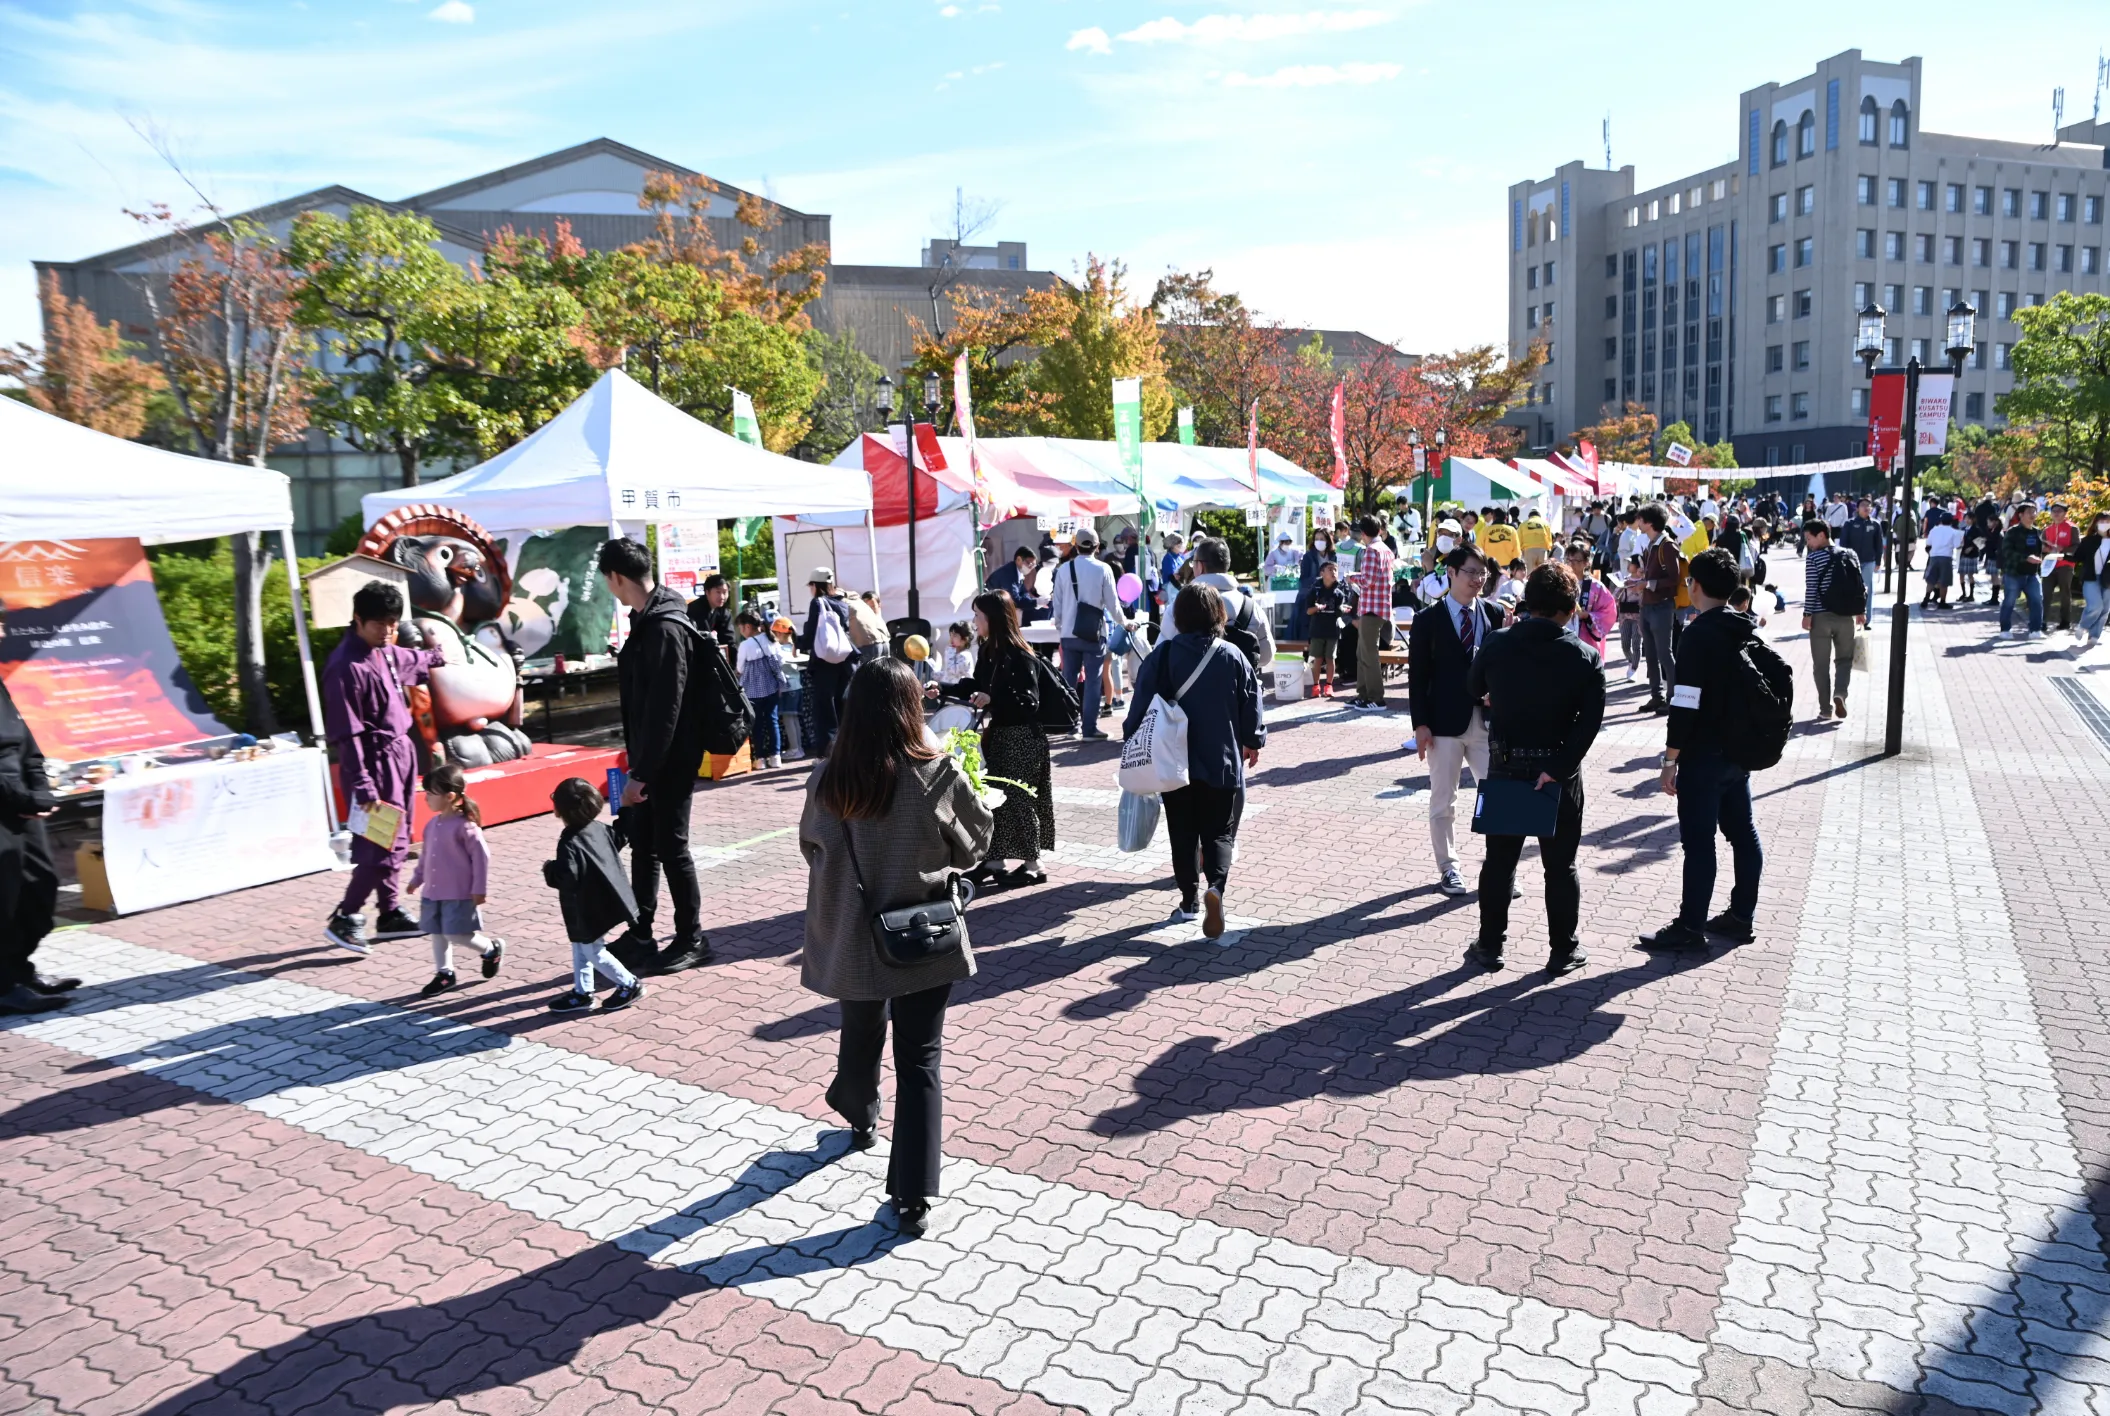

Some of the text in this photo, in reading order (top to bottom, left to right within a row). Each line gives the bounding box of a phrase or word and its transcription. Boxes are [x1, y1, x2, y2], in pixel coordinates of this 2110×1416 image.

[621, 488, 681, 509] 甲賀市
[15, 565, 76, 588] 信楽
[1146, 708, 1158, 759] KINOKUNIYA
